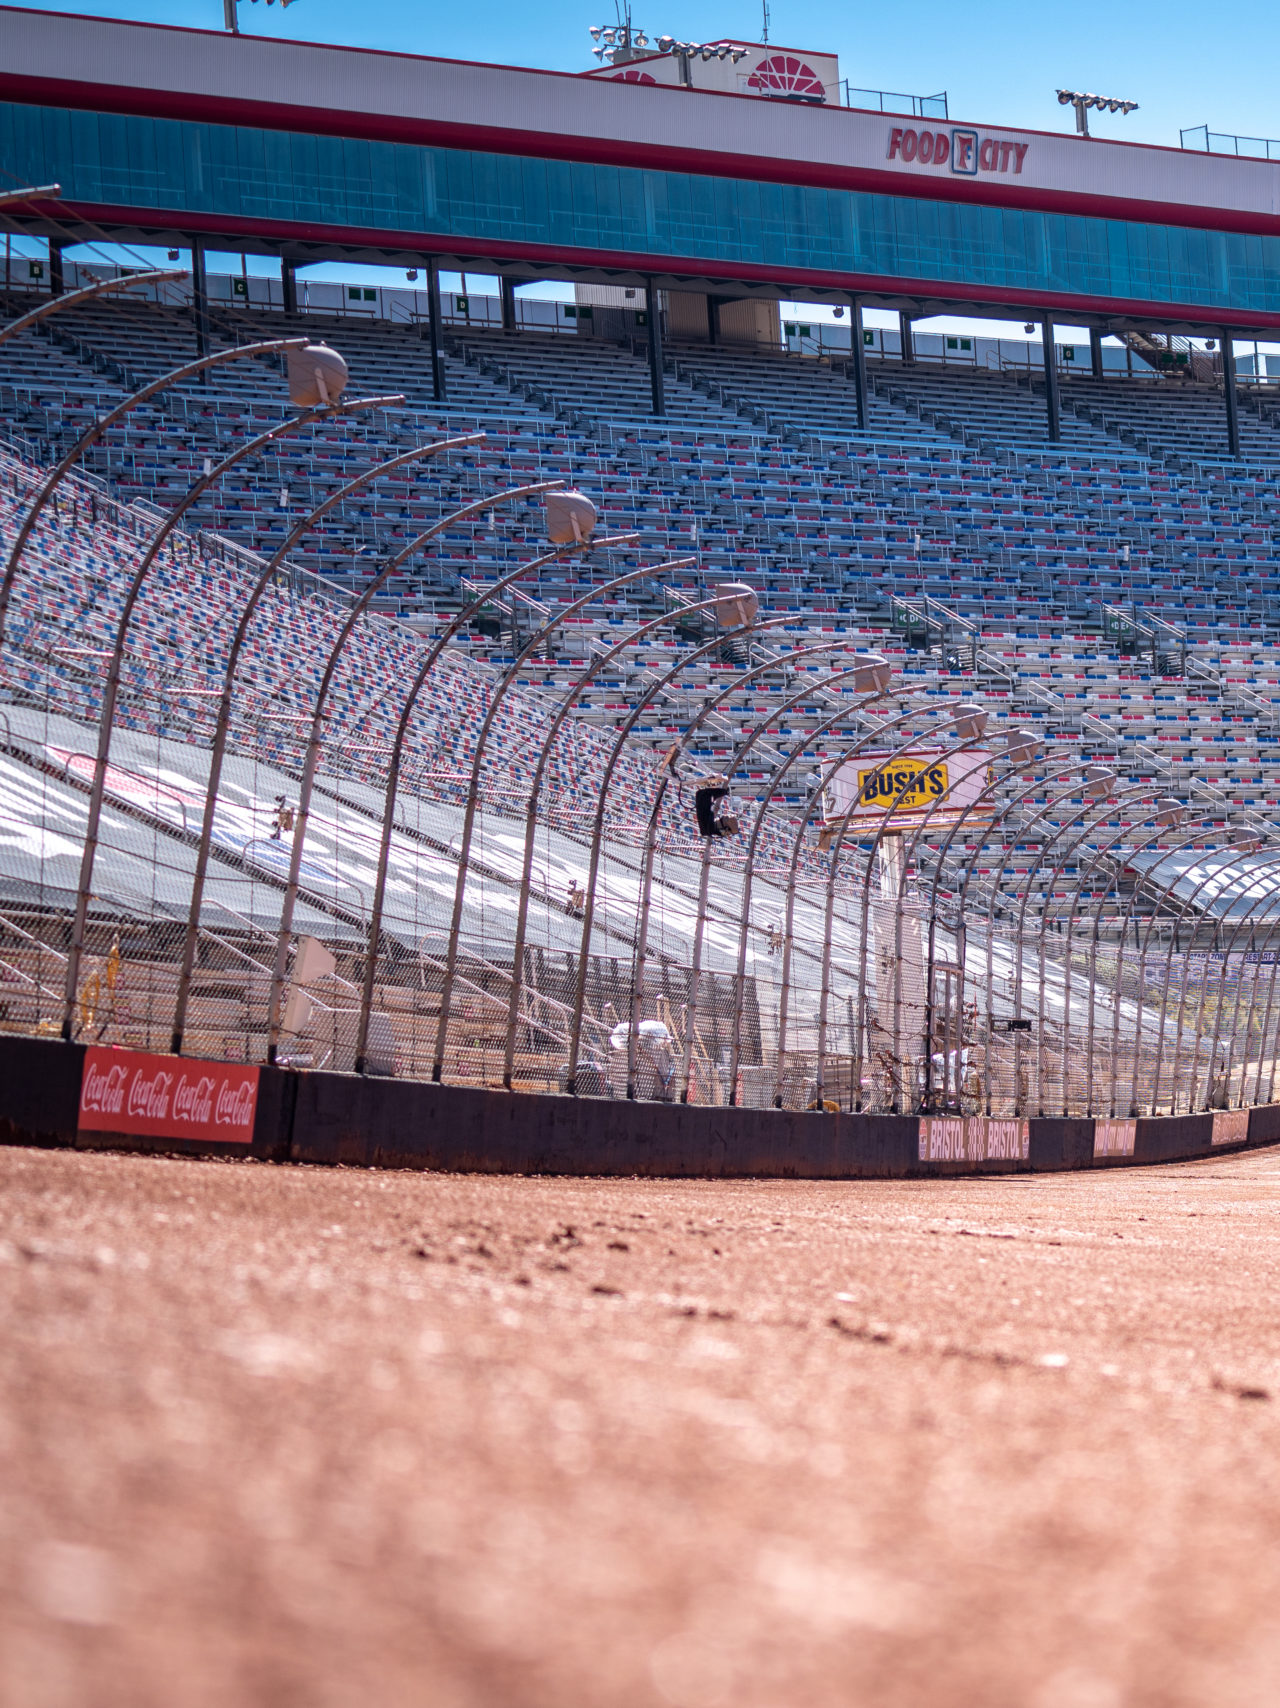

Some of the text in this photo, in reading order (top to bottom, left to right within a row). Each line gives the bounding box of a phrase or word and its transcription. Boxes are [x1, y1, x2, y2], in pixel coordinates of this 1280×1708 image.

[887, 128, 950, 165] FOOD
[979, 138, 1030, 174] CITY
[863, 768, 944, 801] BUSH'S
[930, 1120, 965, 1160] BRISTOL
[987, 1121, 1020, 1159] BRISTOL
